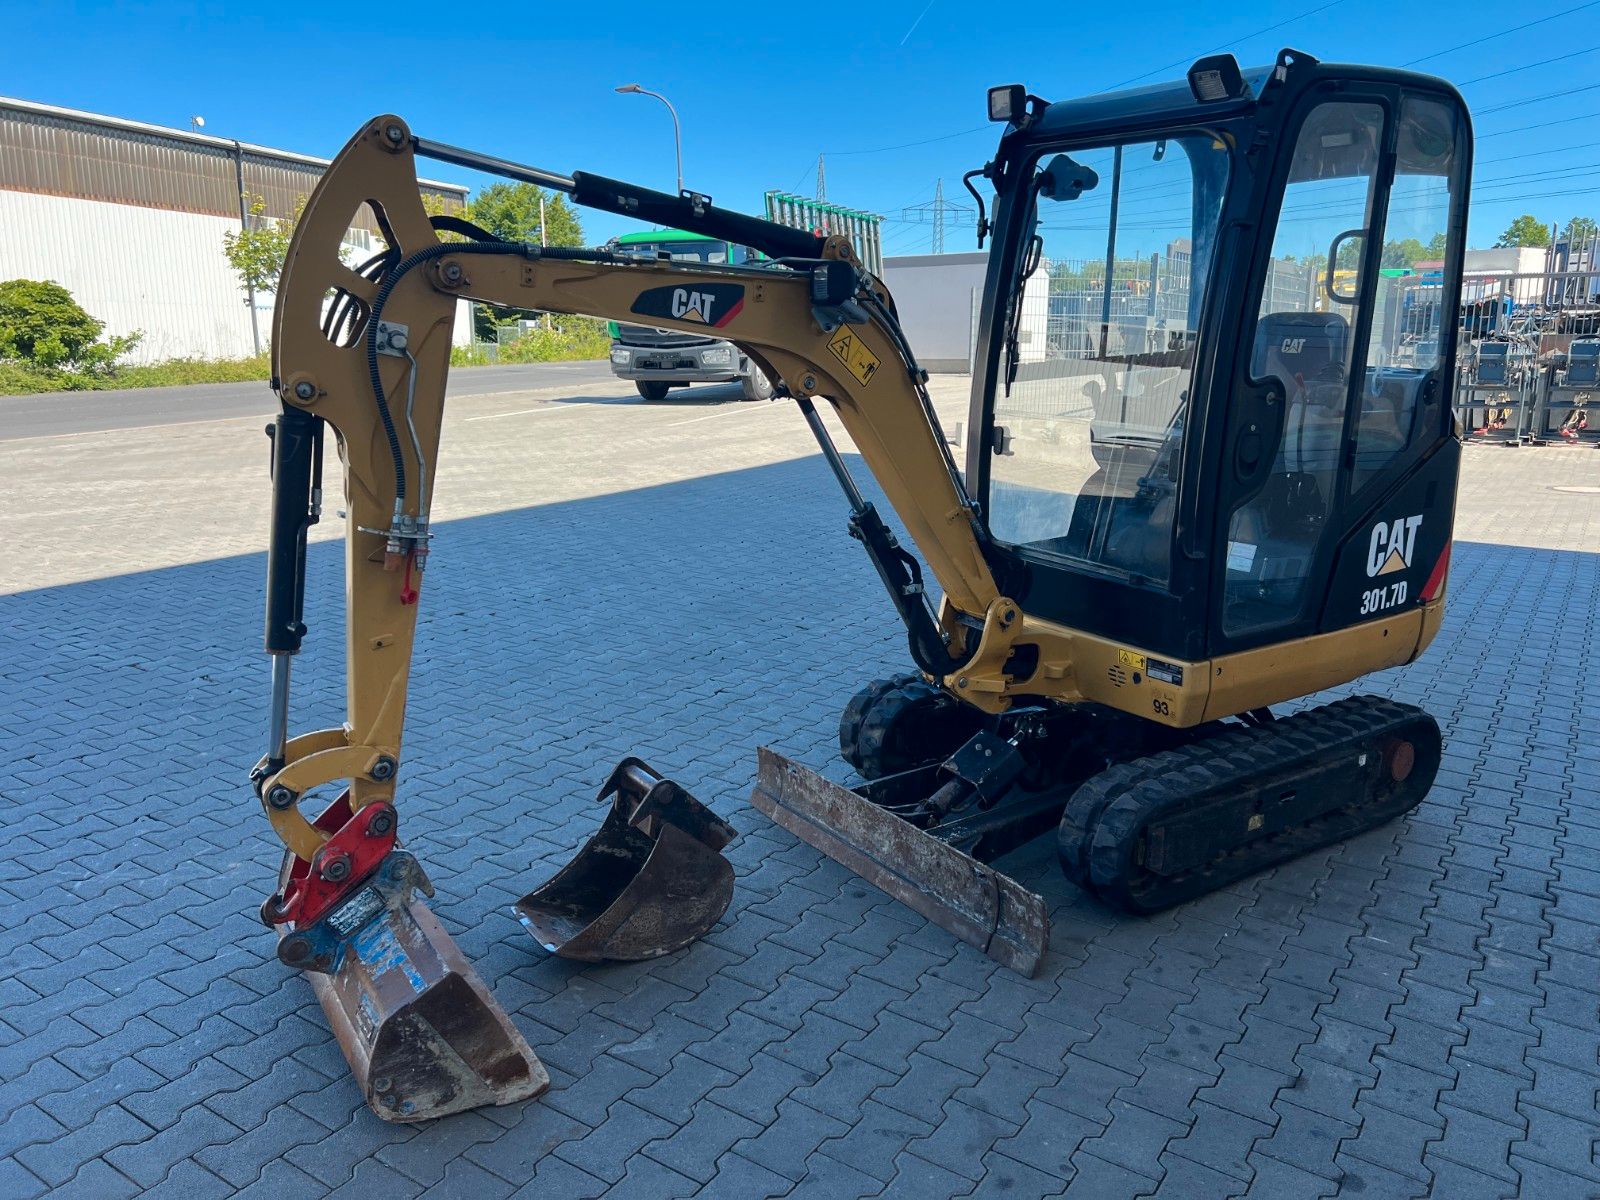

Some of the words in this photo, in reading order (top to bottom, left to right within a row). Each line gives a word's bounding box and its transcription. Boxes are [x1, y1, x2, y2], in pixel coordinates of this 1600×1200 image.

[671, 288, 715, 323] CAT
[1281, 338, 1306, 354] CAT
[1366, 514, 1424, 578] CAT
[1360, 580, 1408, 615] 301.7D
[1153, 699, 1169, 716] 93
